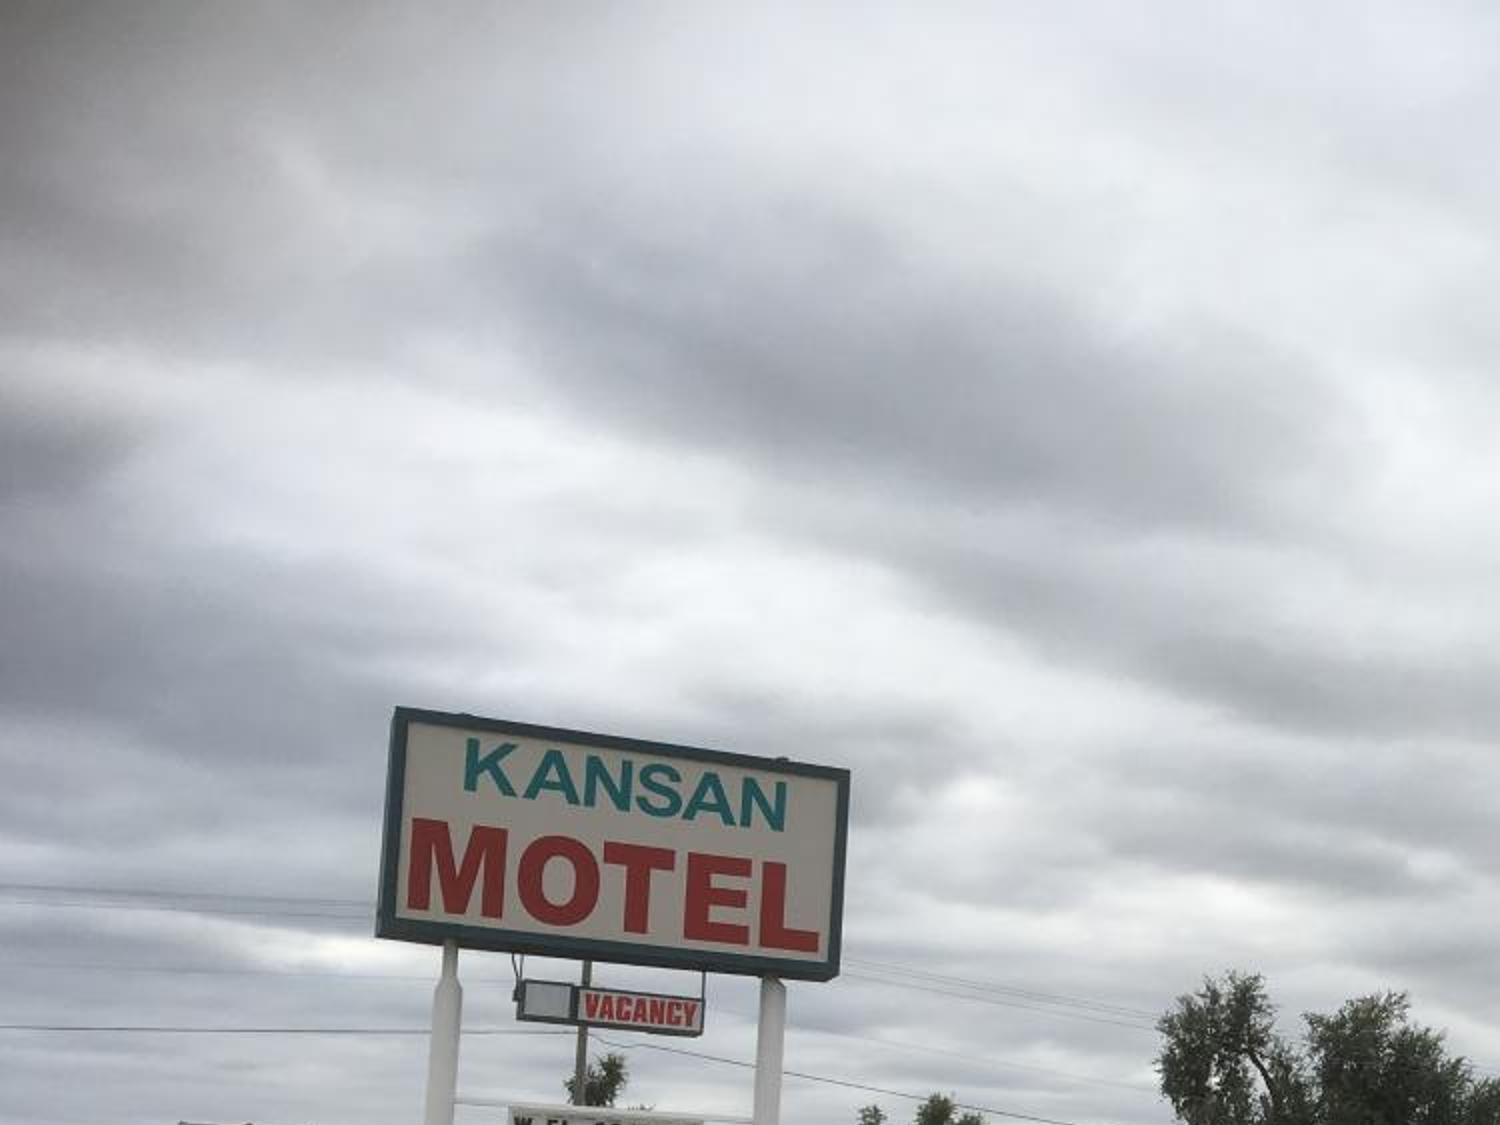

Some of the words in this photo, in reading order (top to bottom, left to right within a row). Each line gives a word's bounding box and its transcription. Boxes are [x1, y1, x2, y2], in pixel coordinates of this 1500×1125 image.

[463, 737, 788, 833] KANSAN
[407, 817, 820, 953] MOTEL
[584, 992, 698, 1027] VACANCY
